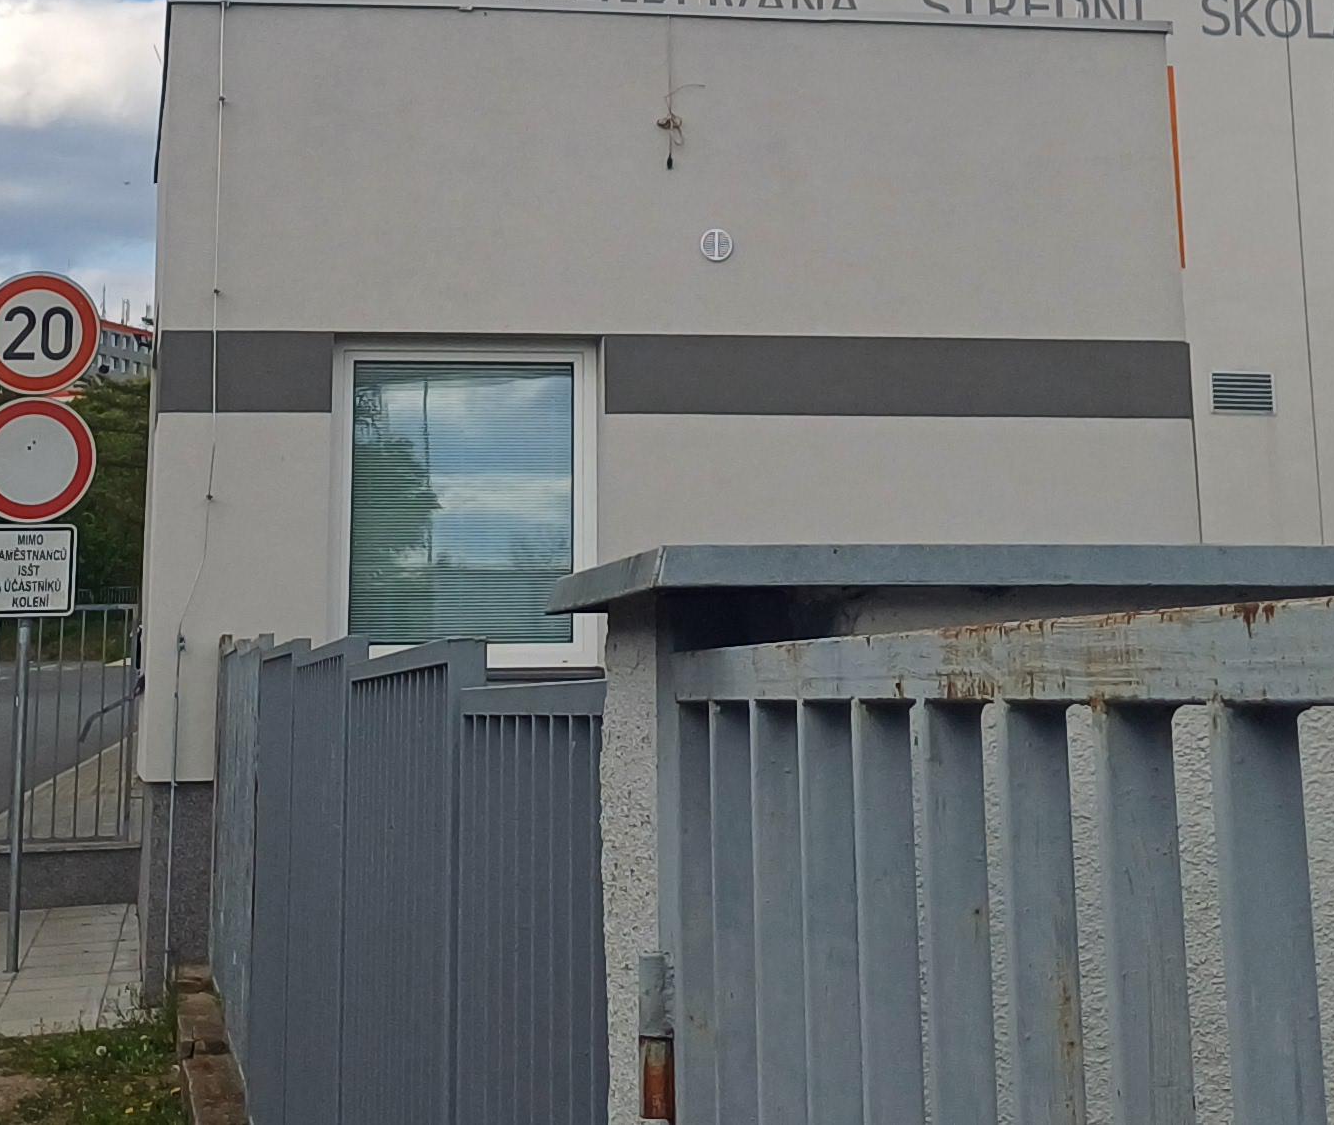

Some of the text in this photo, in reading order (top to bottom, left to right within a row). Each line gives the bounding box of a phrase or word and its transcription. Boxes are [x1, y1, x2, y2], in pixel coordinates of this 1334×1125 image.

[2, 305, 74, 361] 20
[17, 534, 44, 546] MIMO
[17, 563, 41, 577] ISŠT
[4, 578, 62, 593] ÚČASTNÍKŮ
